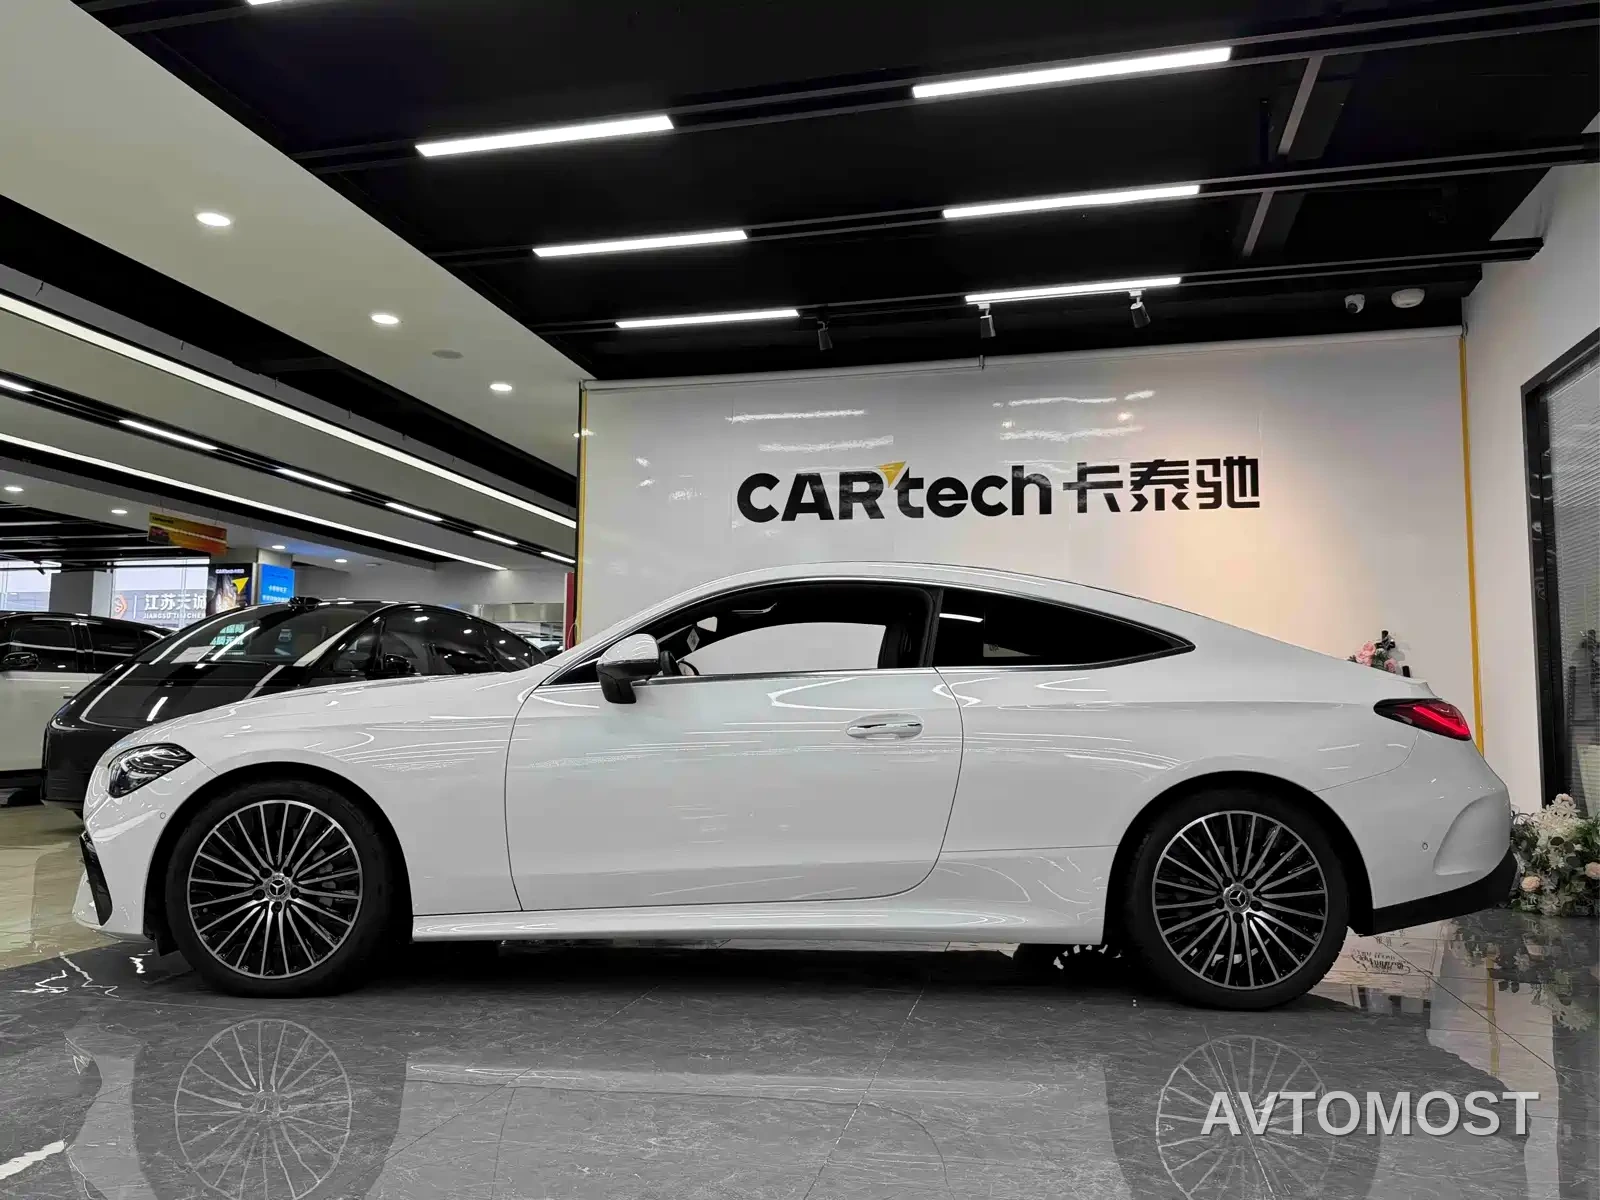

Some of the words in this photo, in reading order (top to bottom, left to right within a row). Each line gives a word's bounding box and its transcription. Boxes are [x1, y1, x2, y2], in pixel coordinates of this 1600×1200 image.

[737, 463, 1052, 523] CARtech
[1062, 457, 1261, 514] 卡泰驰
